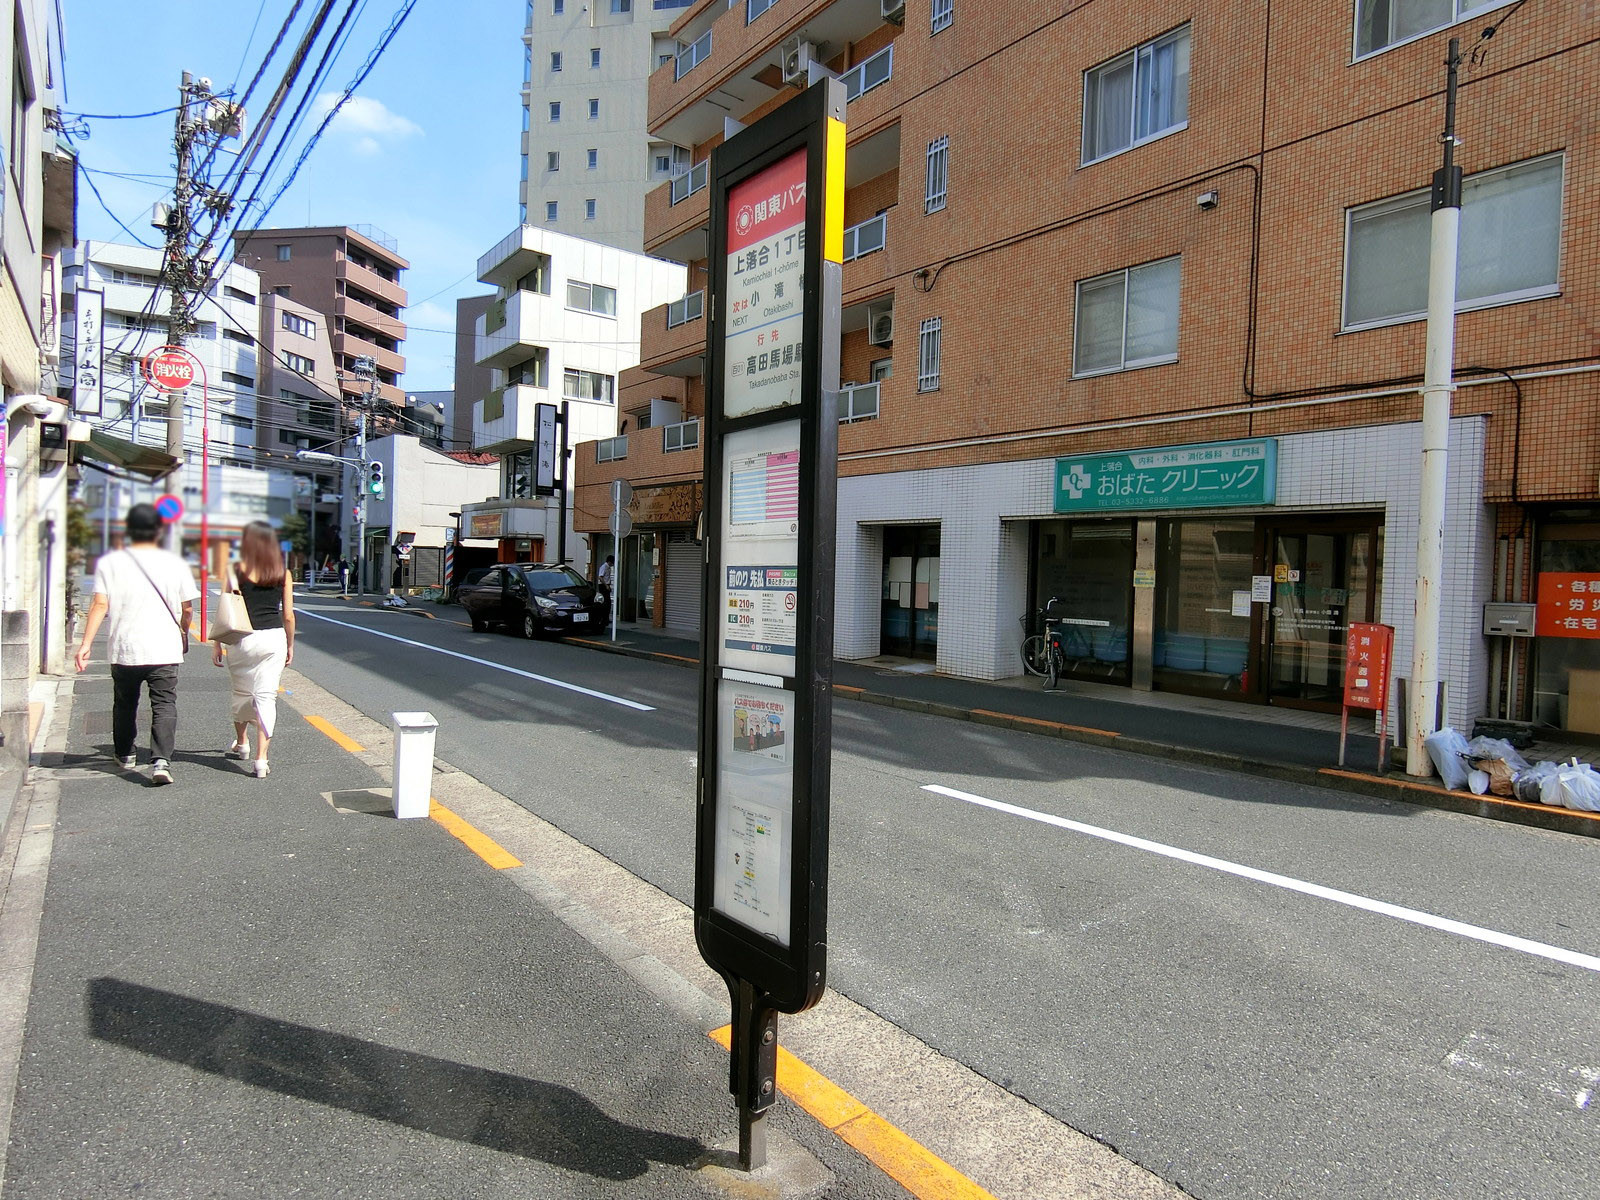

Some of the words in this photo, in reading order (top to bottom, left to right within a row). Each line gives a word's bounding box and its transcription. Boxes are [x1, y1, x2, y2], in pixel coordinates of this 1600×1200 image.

[755, 182, 806, 224] 関東バス
[743, 268, 773, 287] Kamiochiai
[733, 299, 748, 313] 次は
[733, 315, 748, 327] NEXT
[764, 299, 793, 317] Otakibashi
[156, 362, 192, 380] 消火栓
[749, 373, 788, 389] Takadanobaba
[1099, 462, 1123, 473] 上落合
[1097, 473, 1155, 496] おばた
[1161, 464, 1259, 492] クリニック
[729, 569, 748, 587] 前のり
[1563, 617, 1597, 630] 在宅
[1358, 636, 1370, 676] 消火器
